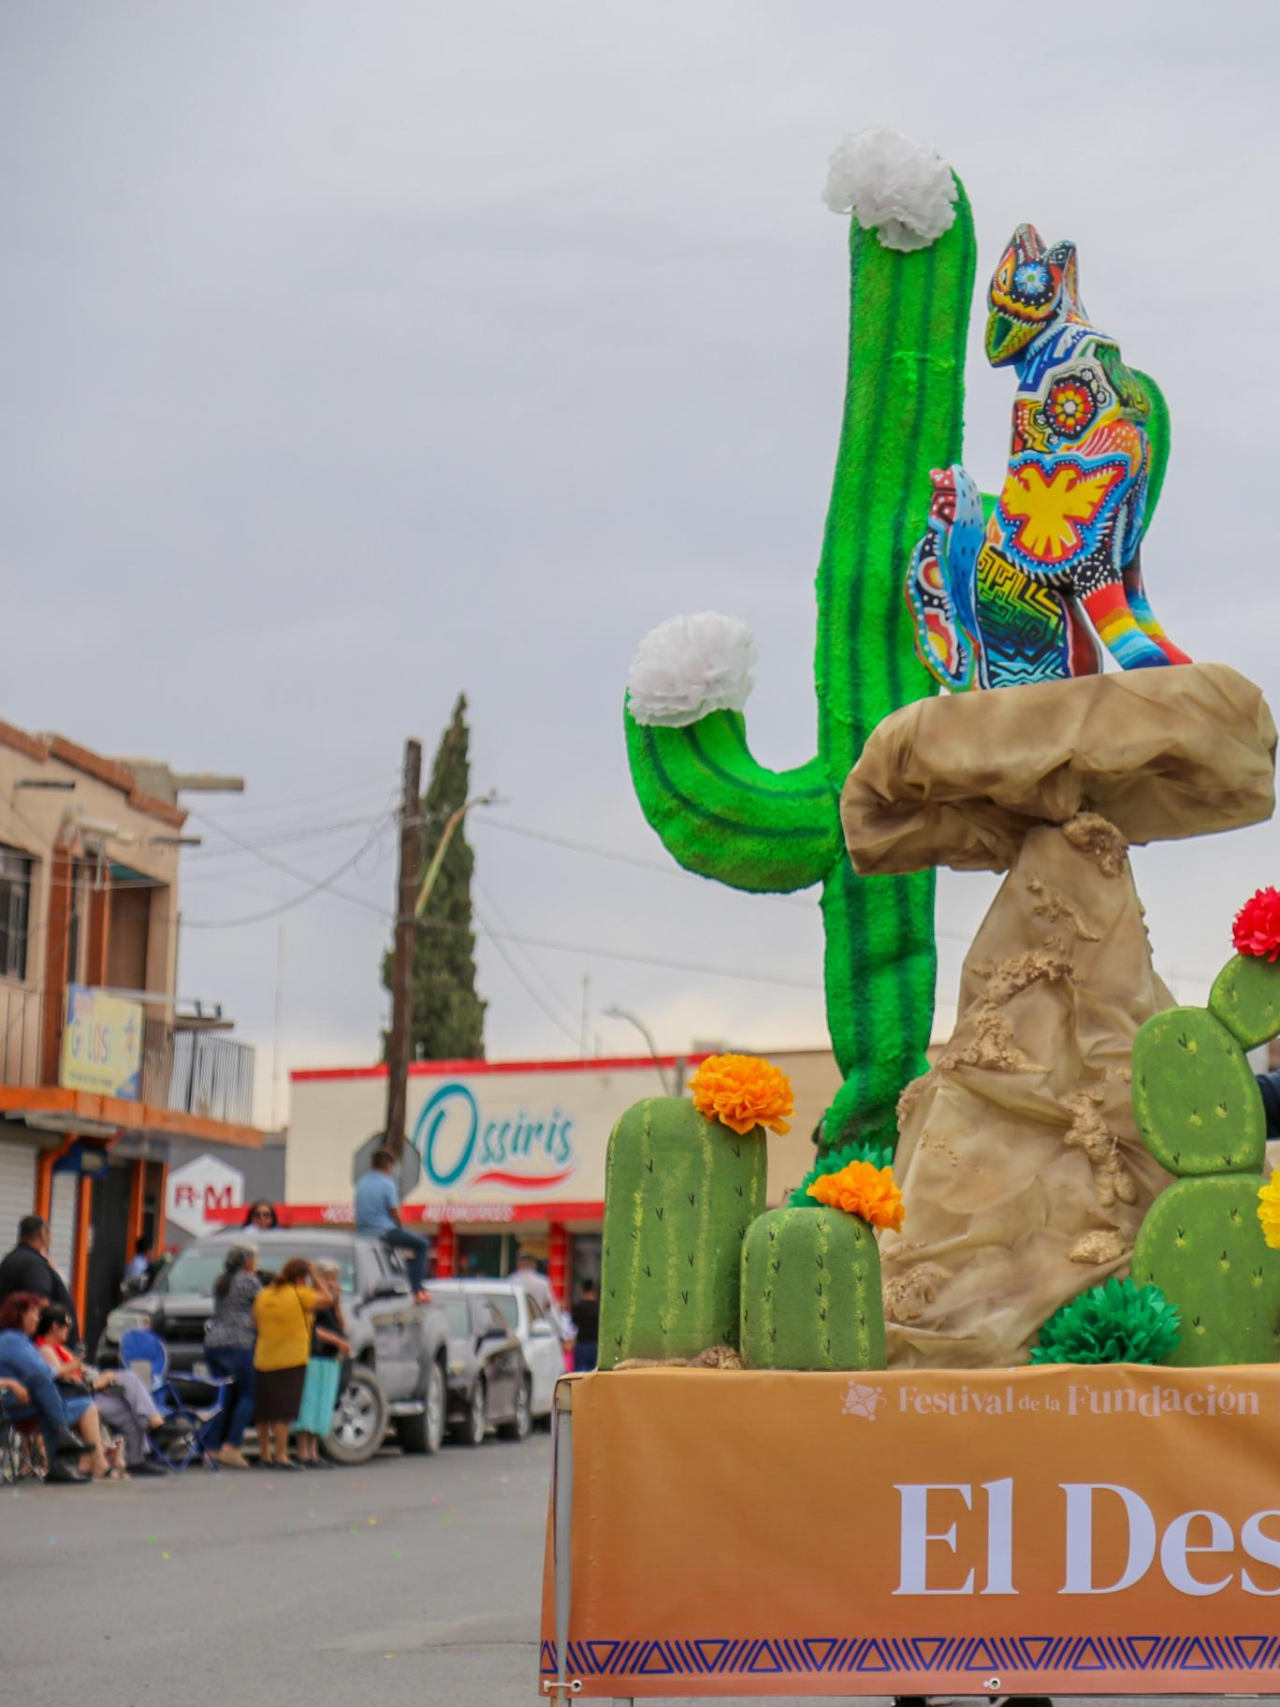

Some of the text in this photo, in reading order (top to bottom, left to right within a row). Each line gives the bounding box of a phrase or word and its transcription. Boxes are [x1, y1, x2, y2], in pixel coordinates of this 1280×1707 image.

[413, 1083, 572, 1187] Ossiris
[898, 1385, 1014, 1416] Festival
[1018, 1388, 1040, 1412] de
[1045, 1388, 1061, 1412] la
[1067, 1384, 1260, 1417] Fundación
[891, 1476, 1020, 1596] El
